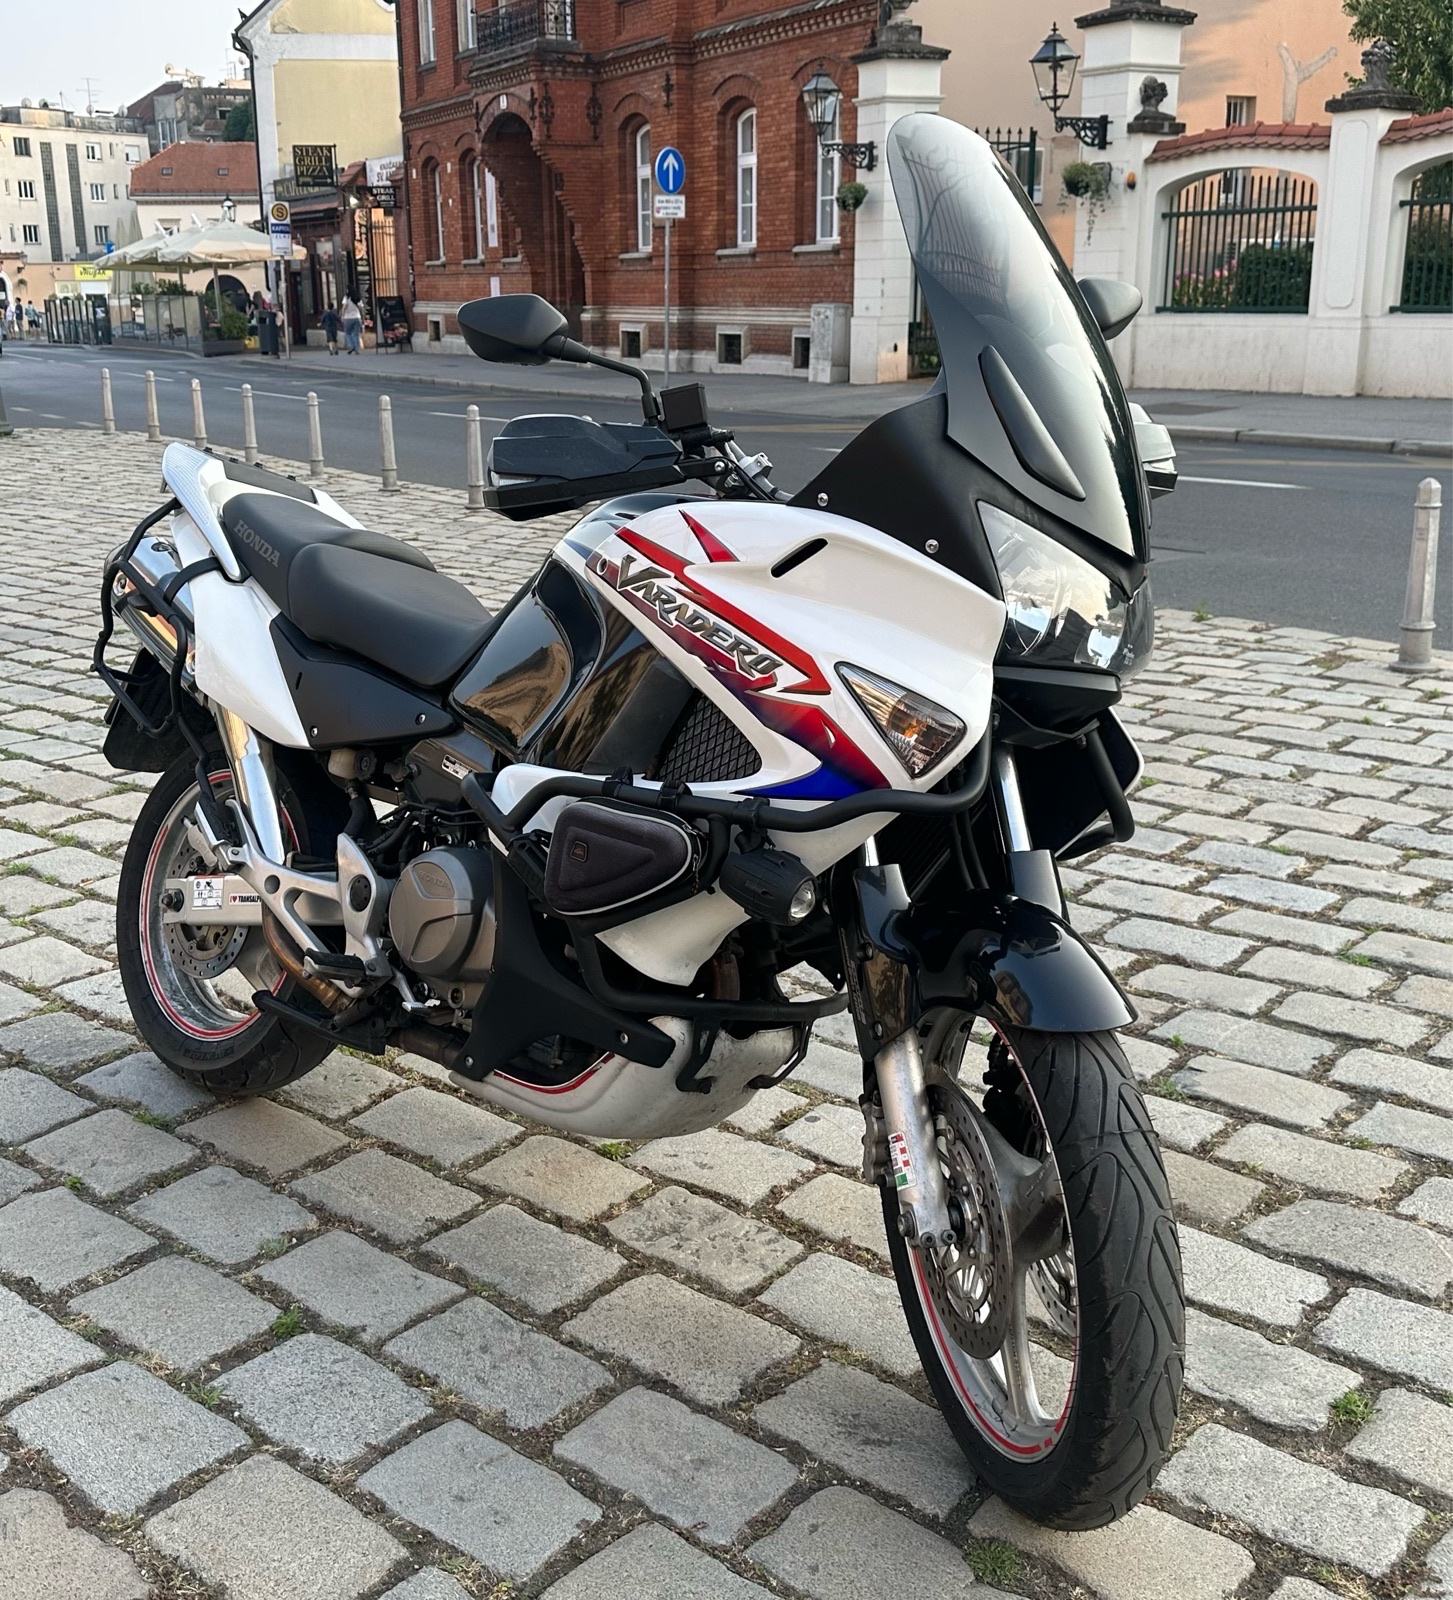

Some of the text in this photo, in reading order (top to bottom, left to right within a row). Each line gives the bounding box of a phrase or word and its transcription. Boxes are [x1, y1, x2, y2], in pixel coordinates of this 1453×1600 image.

[295, 147, 330, 156] STEAK
[296, 156, 330, 166] GRILL
[297, 166, 329, 176] PIZZA
[372, 187, 395, 195] STEAK
[276, 206, 285, 218] S
[233, 519, 280, 568] HONDA
[616, 554, 785, 679] VARADERO
